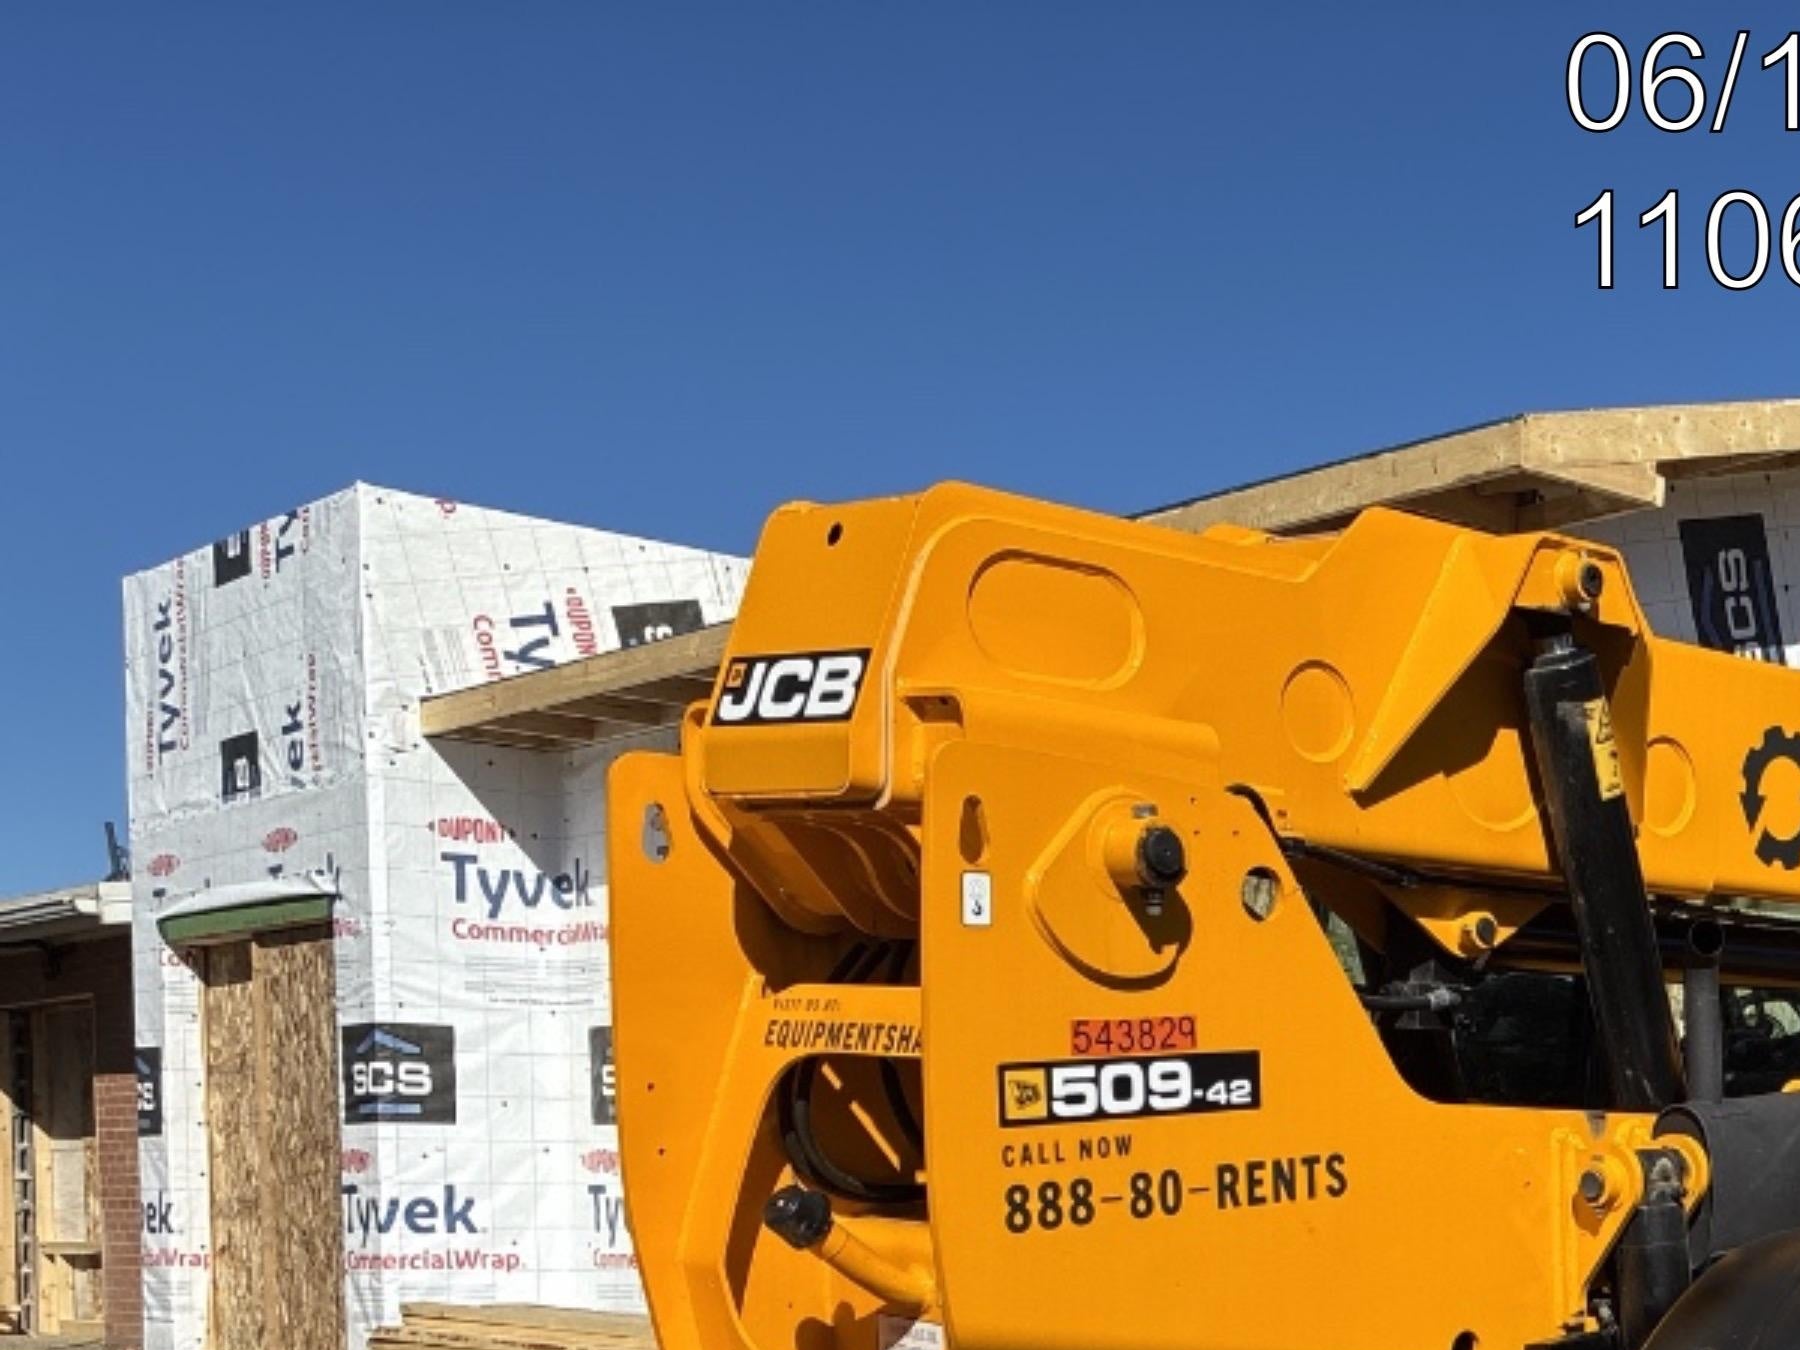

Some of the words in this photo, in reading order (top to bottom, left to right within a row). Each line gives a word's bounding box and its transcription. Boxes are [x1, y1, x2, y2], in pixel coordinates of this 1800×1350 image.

[718, 655, 863, 722] JCB
[440, 851, 593, 919] Tyvek
[1071, 1015, 1198, 1054] 543829
[353, 1060, 434, 1096] SCS
[1002, 1141, 1066, 1168] CALL
[1079, 1134, 1133, 1162] NOW
[141, 1190, 175, 1234] ek
[341, 1183, 480, 1248] Tyvek
[1003, 1151, 1349, 1235] 888-80-RENTS
